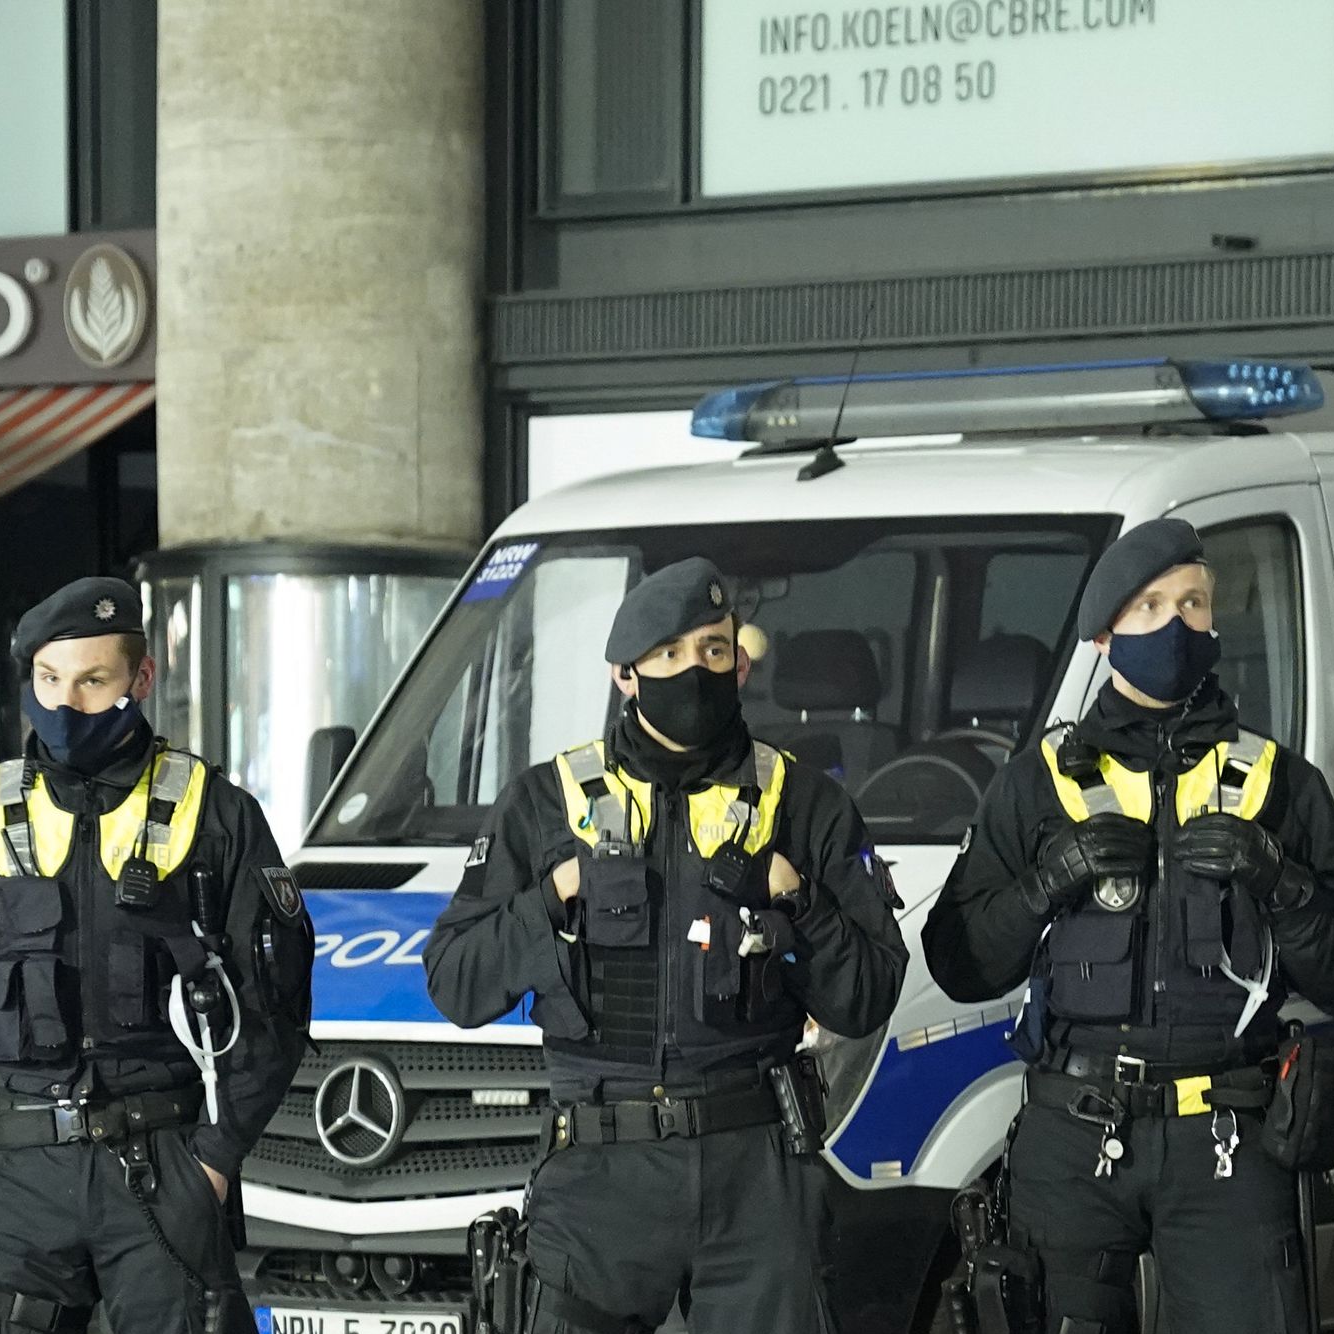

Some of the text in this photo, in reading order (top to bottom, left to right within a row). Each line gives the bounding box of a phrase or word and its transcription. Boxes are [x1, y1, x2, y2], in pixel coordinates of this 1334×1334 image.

[759, 0, 1157, 54] INFO.KOELN@CBRE.COM
[757, 72, 833, 116] 0221
[860, 68, 890, 110] 17
[899, 64, 944, 107] 08
[953, 59, 998, 102] 50
